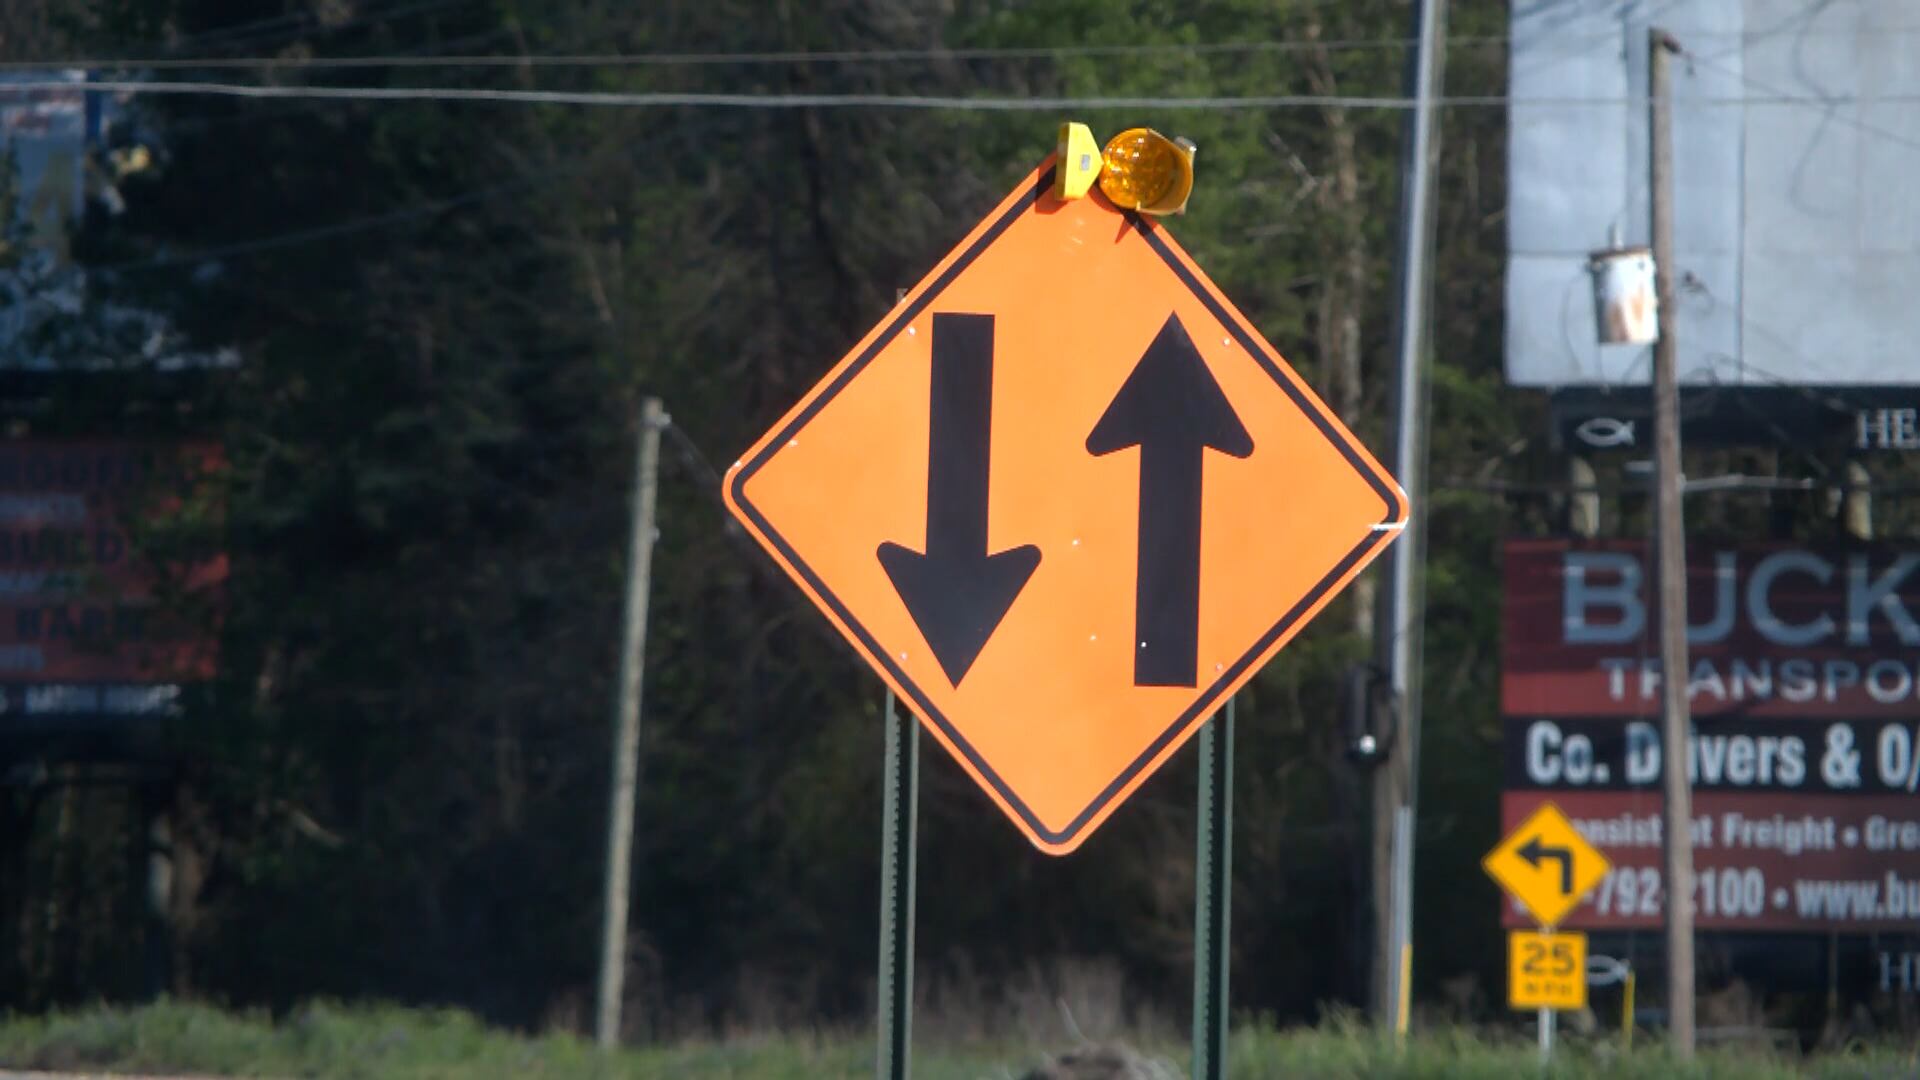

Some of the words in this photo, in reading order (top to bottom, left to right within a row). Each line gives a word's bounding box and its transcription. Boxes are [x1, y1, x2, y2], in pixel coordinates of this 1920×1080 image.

[1600, 659, 1920, 702] TRANSPO
[1526, 720, 1610, 784] Co.
[1625, 722, 1806, 786] Divers
[1822, 723, 1861, 787] &
[1723, 814, 1834, 855] Freight
[1864, 815, 1920, 851] Gre
[1523, 941, 1576, 977] 25
